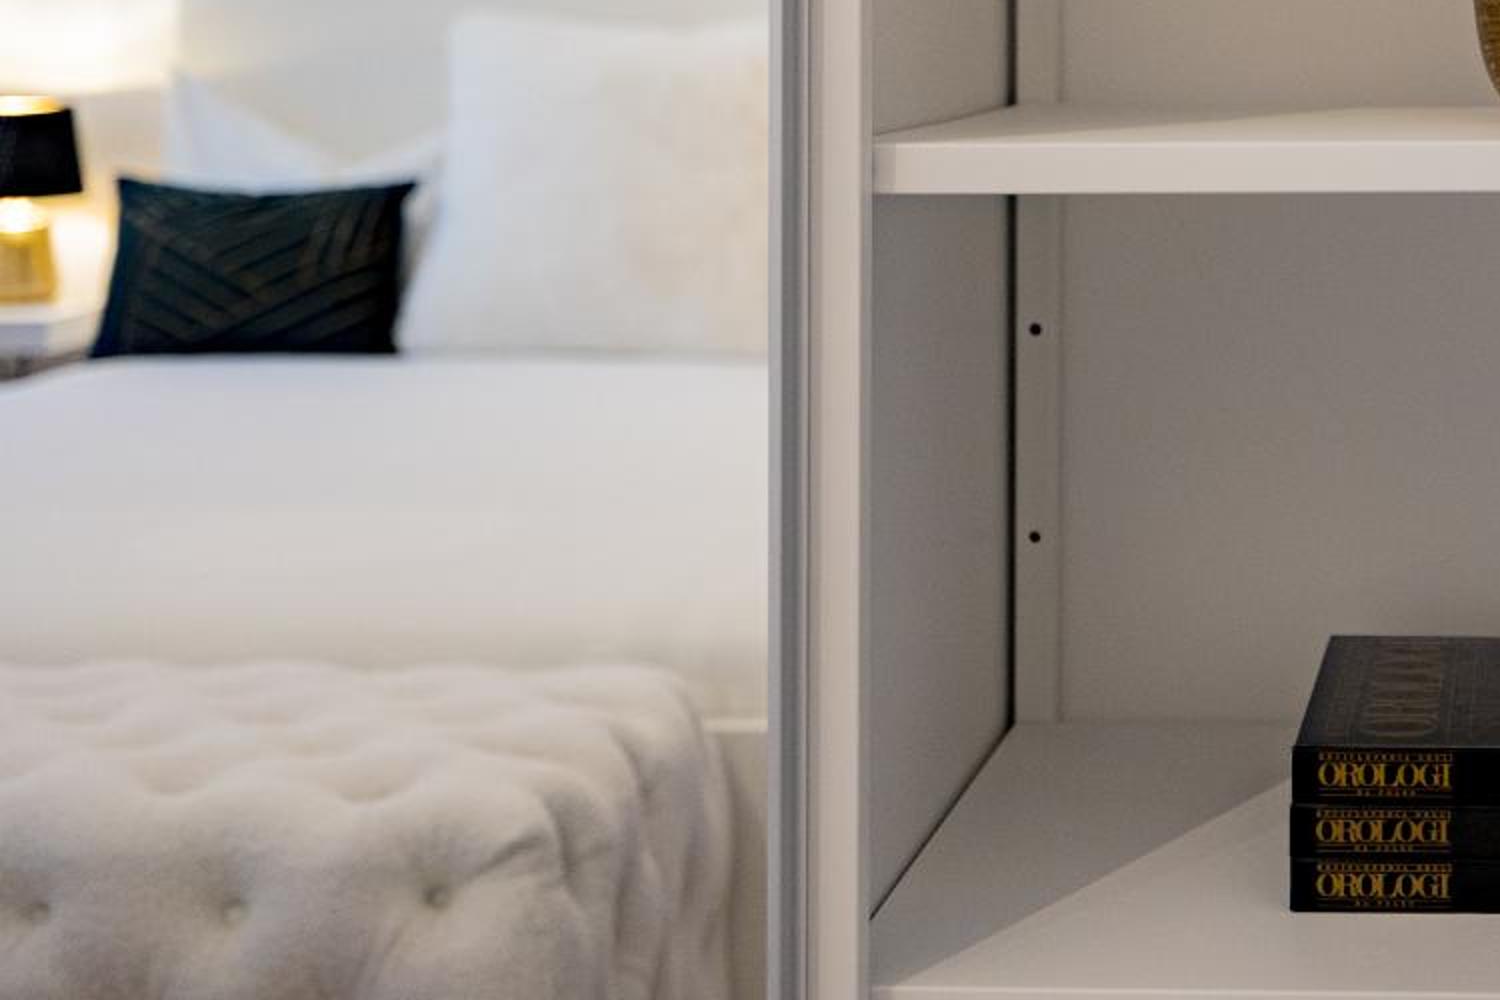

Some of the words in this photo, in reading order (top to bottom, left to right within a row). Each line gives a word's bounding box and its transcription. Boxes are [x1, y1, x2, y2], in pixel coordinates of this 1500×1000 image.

[1316, 761, 1453, 788] OROLOGI
[1314, 818, 1450, 842] OROLOGI
[1314, 872, 1451, 898] OROLOGI
